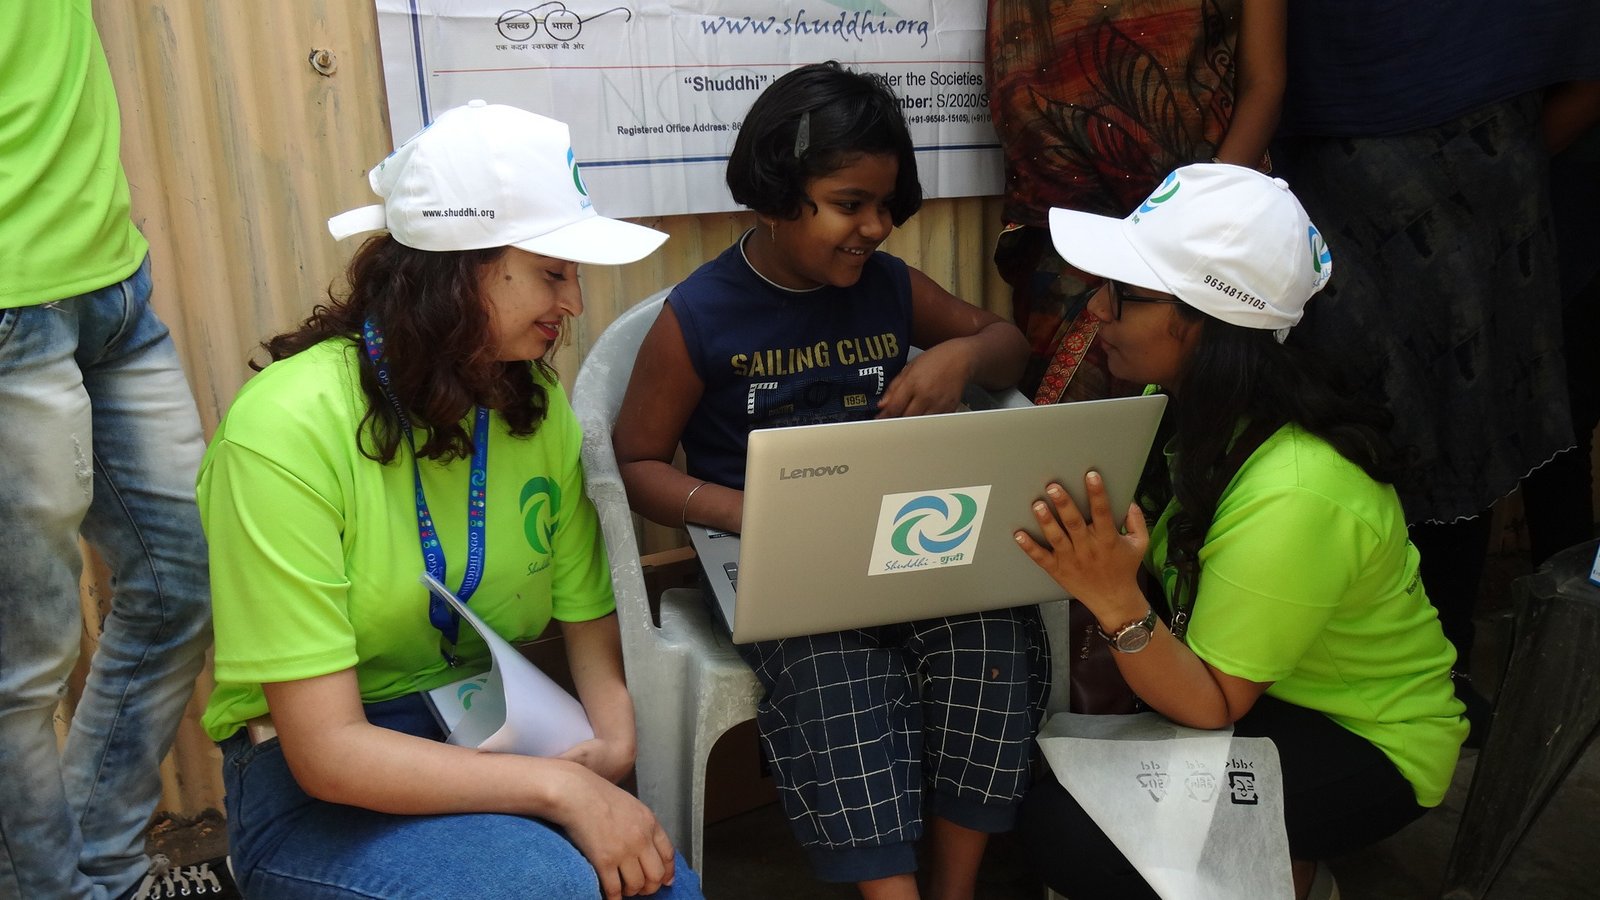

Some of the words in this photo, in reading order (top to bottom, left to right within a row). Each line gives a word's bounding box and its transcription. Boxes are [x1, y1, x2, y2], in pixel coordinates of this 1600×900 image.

[551, 22, 574, 30] भारत
[700, 9, 929, 48] www.shuddhi.org
[906, 72, 926, 86] the
[930, 71, 983, 86] Societies
[617, 125, 664, 137] Registered
[665, 123, 691, 134] Office
[692, 121, 730, 134] Address:
[422, 207, 495, 219] www.shuddhi.org
[1204, 274, 1267, 311] 9654815105
[731, 341, 830, 377] SAILING
[836, 333, 899, 366] CLUB
[779, 464, 849, 480] Lenovo
[884, 557, 929, 571] Shuddhi
